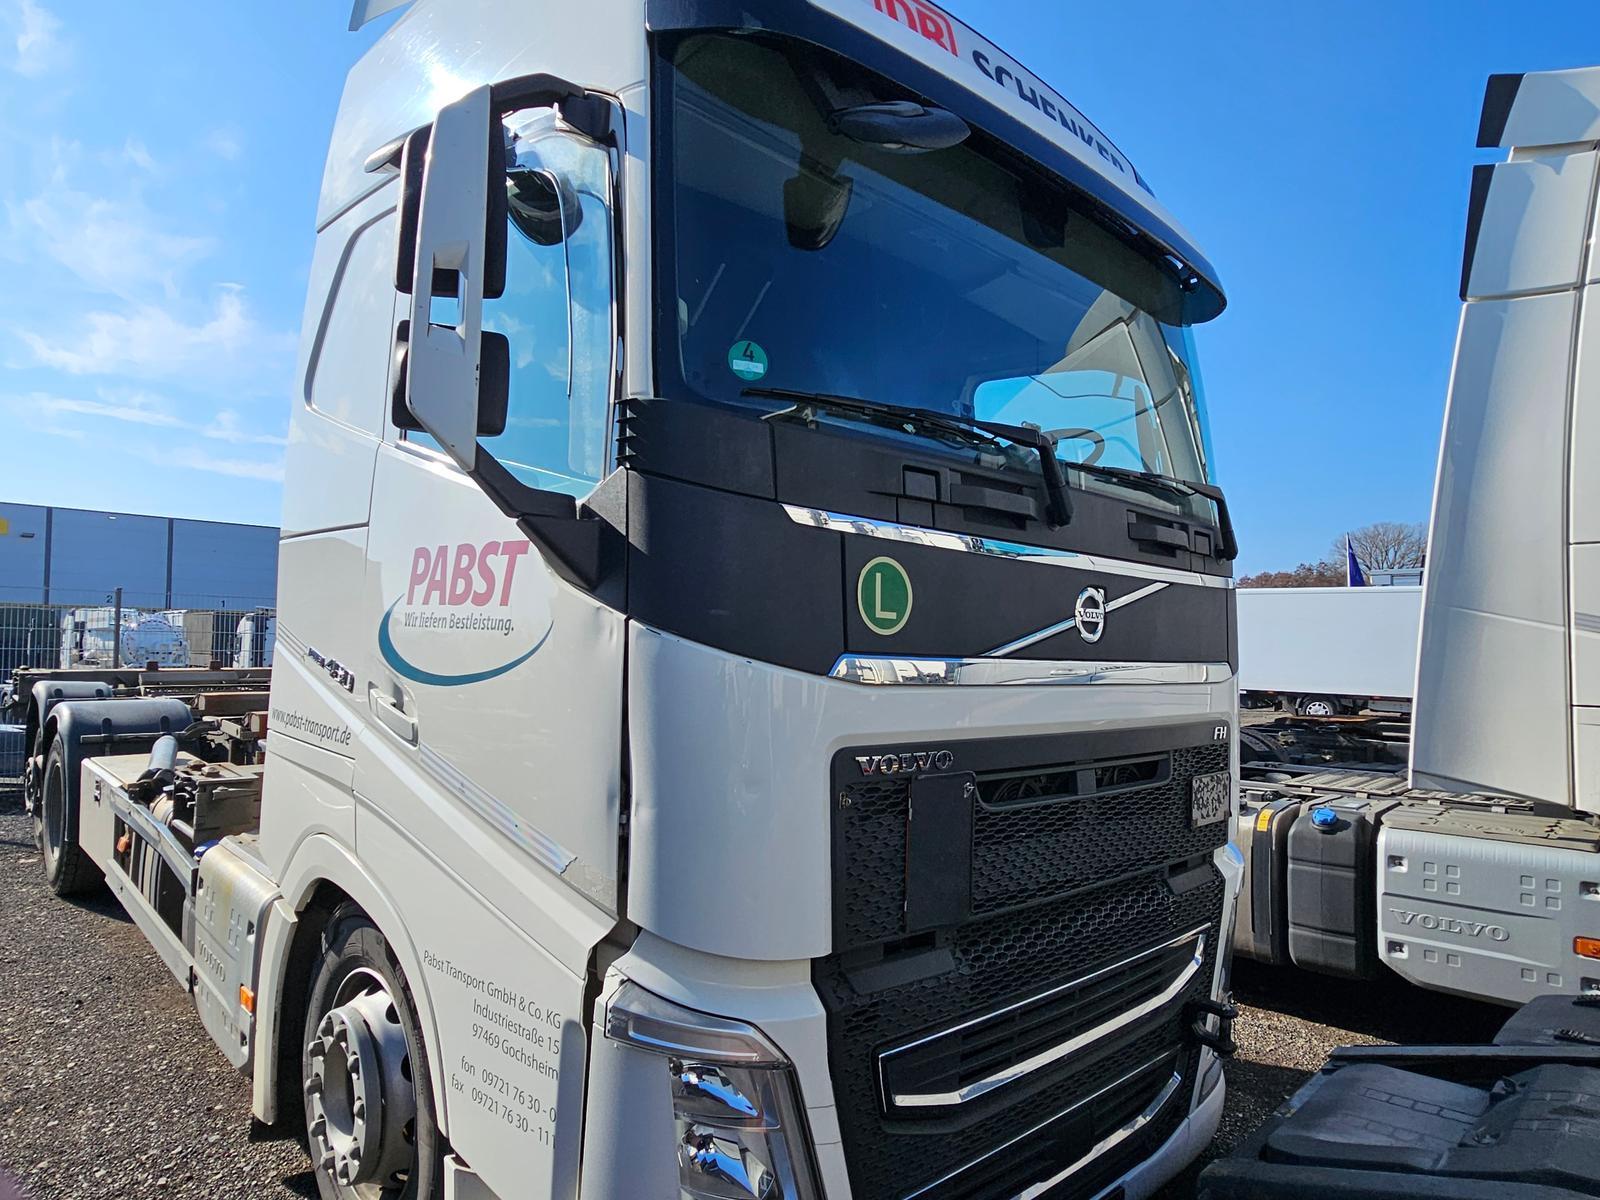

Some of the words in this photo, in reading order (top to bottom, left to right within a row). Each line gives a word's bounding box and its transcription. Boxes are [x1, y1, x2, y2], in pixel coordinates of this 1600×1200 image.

[742, 341, 755, 362] 4
[406, 540, 531, 607] PABST
[106, 594, 113, 604] 2
[875, 572, 897, 620] L
[1077, 608, 1104, 620] VOLVO
[404, 611, 417, 627] Wir
[418, 611, 448, 629] liefern
[449, 613, 514, 637] Bestleistung.
[271, 707, 352, 746] www.pabst-transport.de
[1213, 726, 1228, 740] FH
[855, 750, 954, 776] VOLVO
[1388, 907, 1510, 942] VOLVO
[423, 950, 445, 973] Pabst
[445, 960, 485, 993] Transport
[486, 981, 517, 1008] GmbH
[518, 996, 526, 1012] &
[528, 1001, 544, 1022] Co.
[546, 1008, 561, 1029] KG
[473, 998, 545, 1048] Industriestraße
[547, 1036, 560, 1055] 15
[472, 1023, 500, 1049] 97469
[501, 1039, 559, 1081] Gochsheim
[451, 1073, 465, 1093] fax
[471, 1087, 499, 1116] 09721
[502, 1104, 514, 1124] 76
[515, 1113, 529, 1133] 30
[461, 1055, 476, 1077] fon
[481, 1068, 510, 1097] 09721
[513, 1086, 525, 1105] 76
[527, 1094, 541, 1114] 30
[549, 1107, 557, 1123] 0
